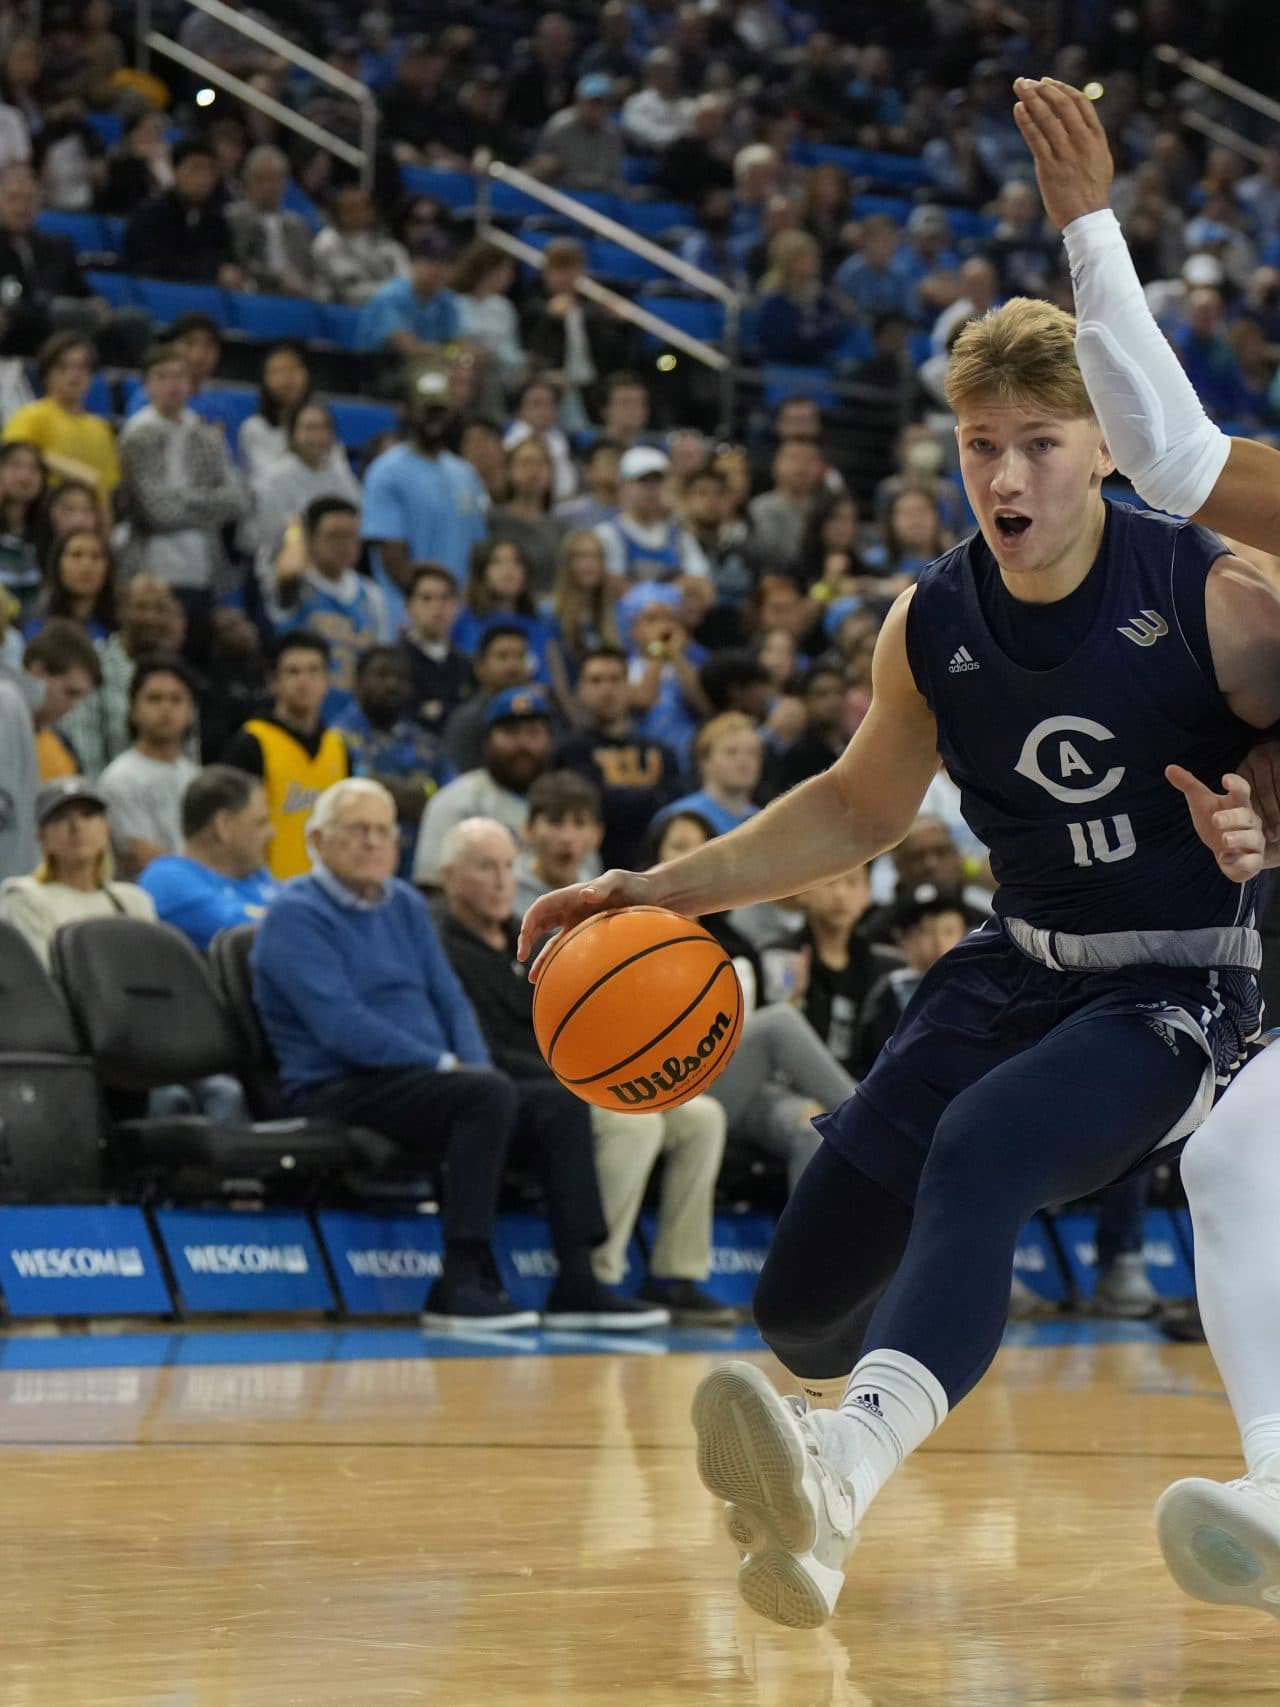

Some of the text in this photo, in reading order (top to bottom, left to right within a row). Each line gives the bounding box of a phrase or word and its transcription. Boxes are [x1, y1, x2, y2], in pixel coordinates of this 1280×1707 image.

[948, 660, 981, 674] adidas
[607, 1011, 733, 1105] Wilson
[11, 1248, 121, 1278] WESCOM
[184, 1245, 284, 1274] WESCOM
